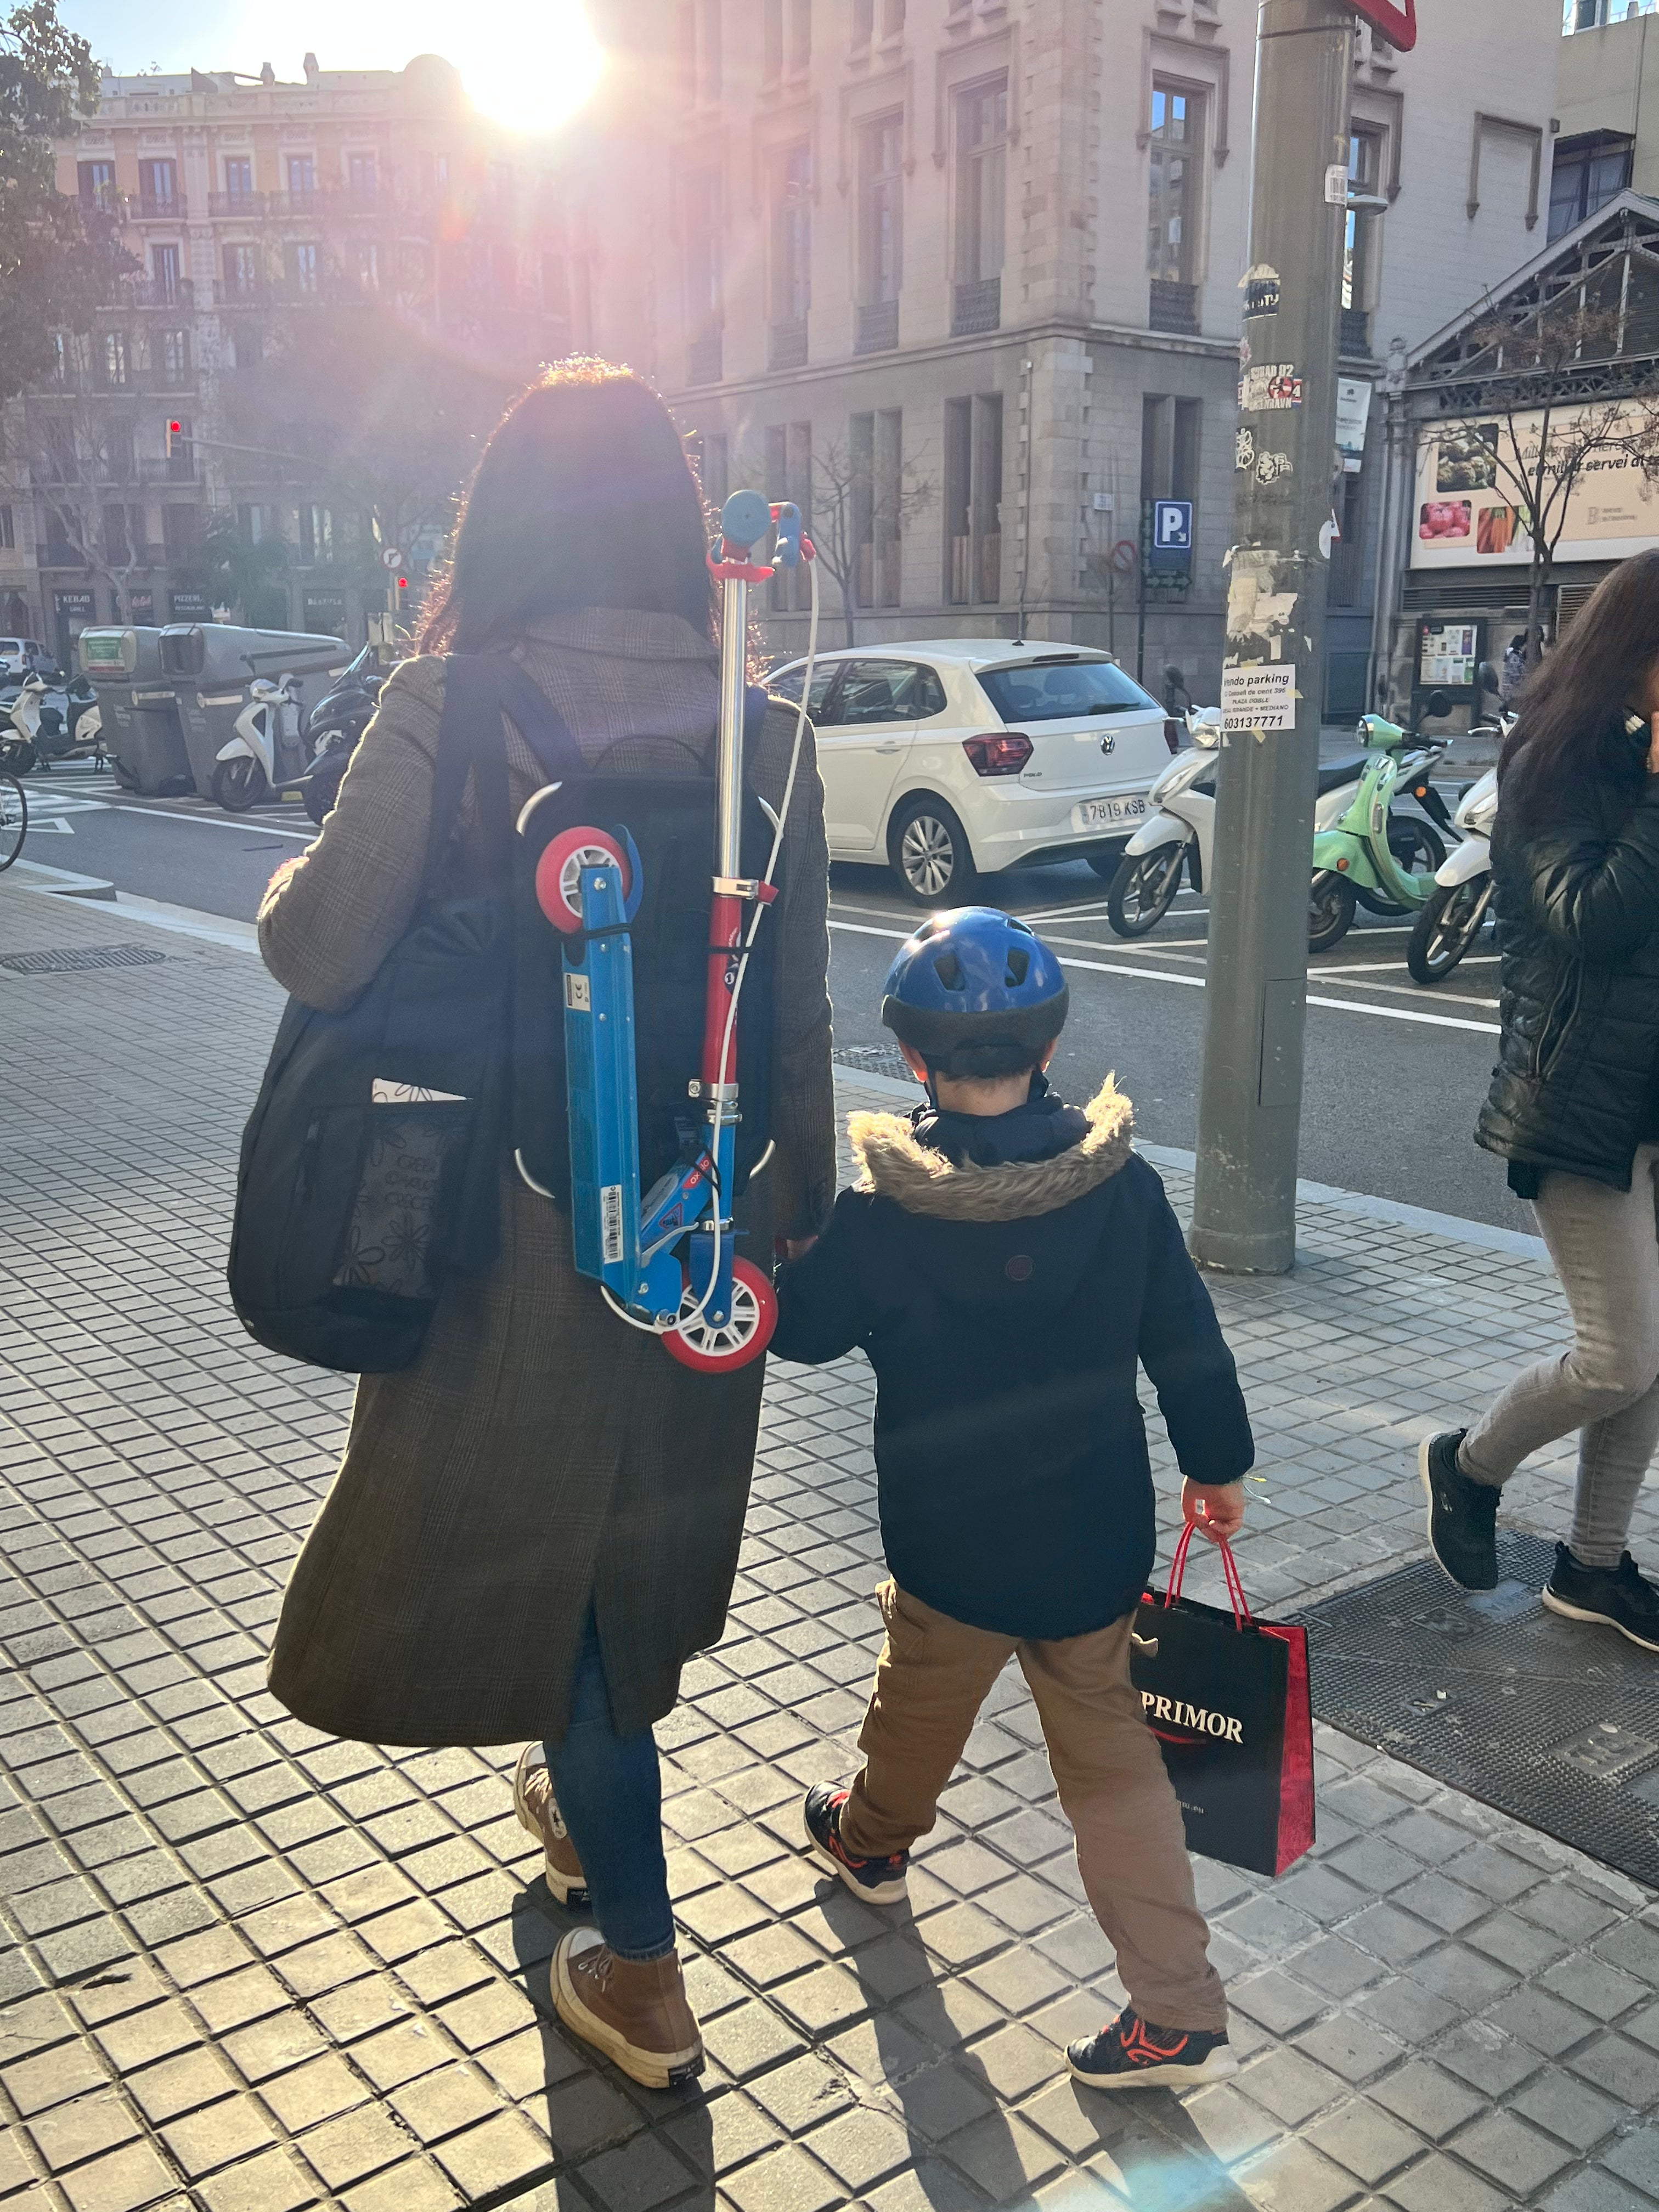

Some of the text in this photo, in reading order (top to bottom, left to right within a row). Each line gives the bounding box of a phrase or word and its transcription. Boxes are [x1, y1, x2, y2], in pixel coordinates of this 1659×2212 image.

[1585, 454, 1628, 471] servei
[1162, 507, 1183, 542] P
[63, 595, 91, 603] KEBAB
[1247, 674, 1289, 687] parking
[1224, 715, 1283, 730] 603137771
[1090, 799, 1146, 820] 7819 KSB
[1140, 1691, 1243, 1744] PRIMOR
